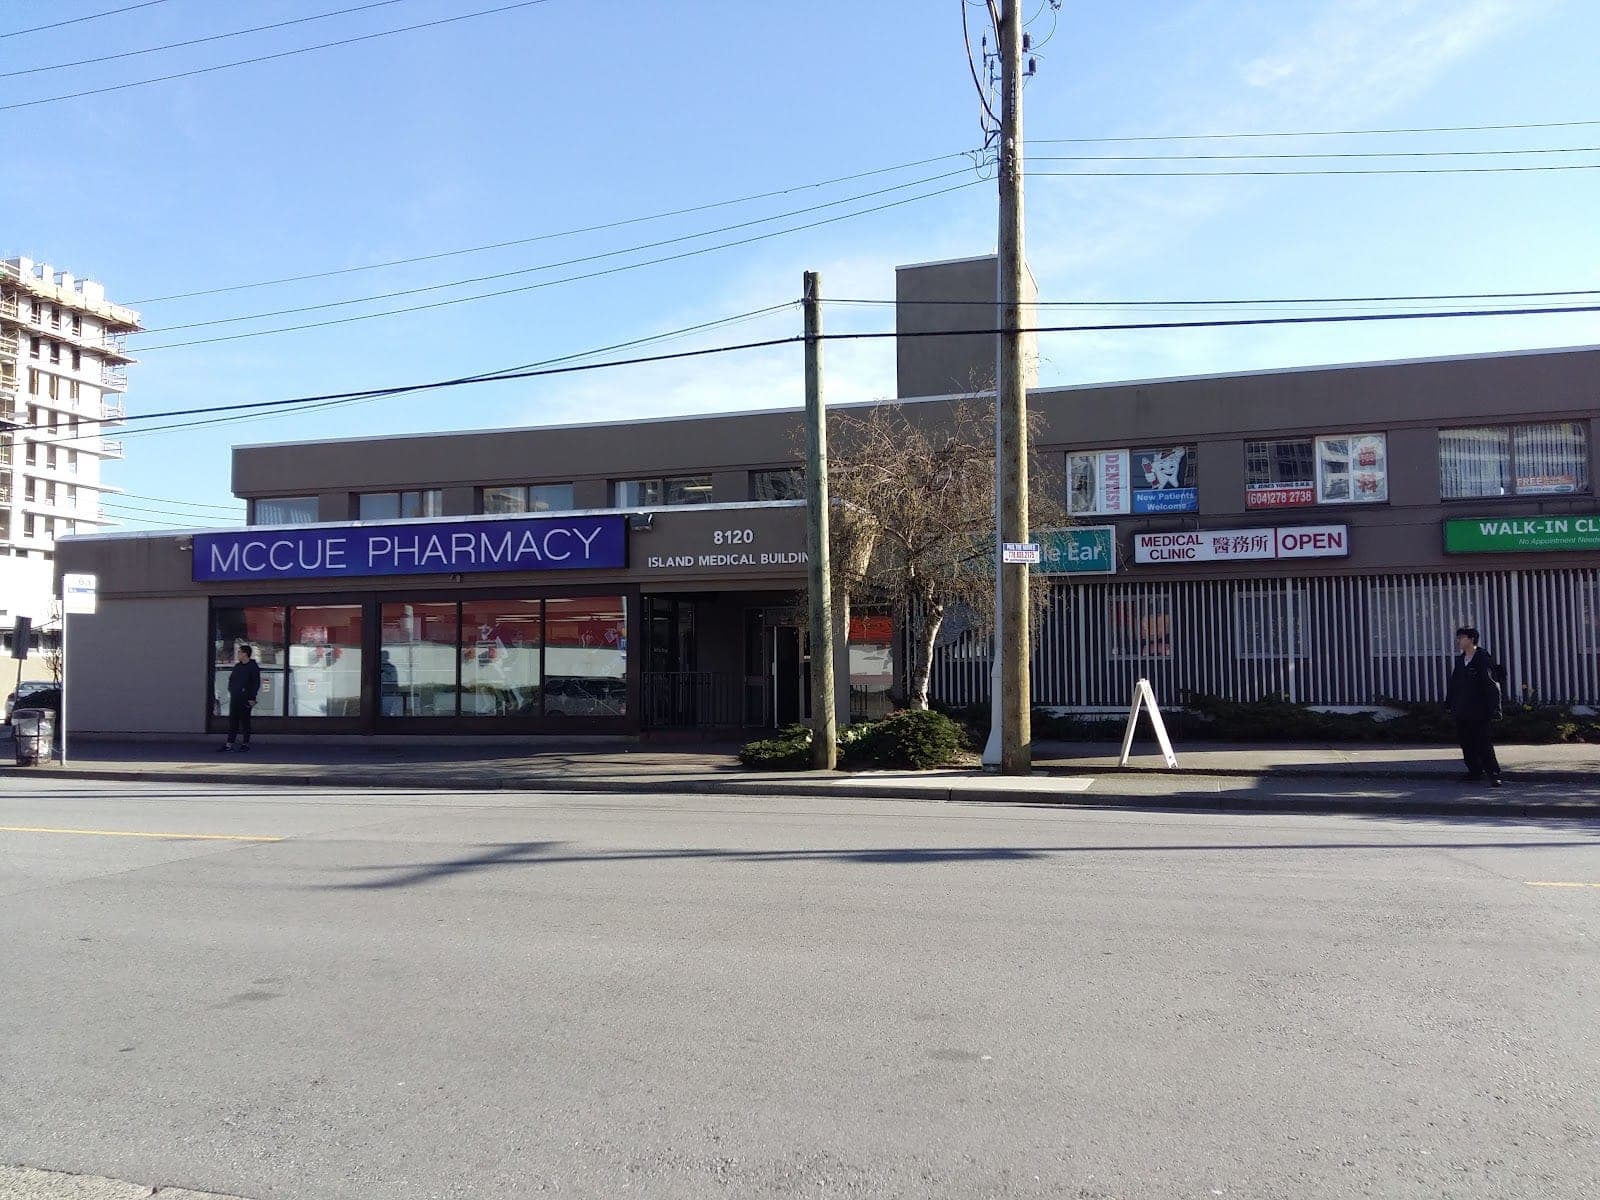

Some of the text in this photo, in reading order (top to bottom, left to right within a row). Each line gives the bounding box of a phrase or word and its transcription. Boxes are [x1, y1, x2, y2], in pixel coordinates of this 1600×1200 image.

[1105, 455, 1119, 509] DENTIST
[1517, 478, 1543, 486] FREE
[1290, 490, 1312, 502] 2738
[1148, 502, 1186, 510] Welcome
[1480, 519, 1600, 536] WALK-IN CL
[714, 529, 754, 544] 8120
[1142, 534, 1204, 548] MEDICAL
[1282, 532, 1342, 551] OPEN
[1530, 537, 1576, 545] Appointment
[211, 526, 602, 573] MCCUE PHARMACY
[1212, 535, 1268, 554] 醫務所
[648, 552, 809, 568] ISLAND MEDICAL BUILDIN
[1150, 548, 1196, 560] CLINIC
